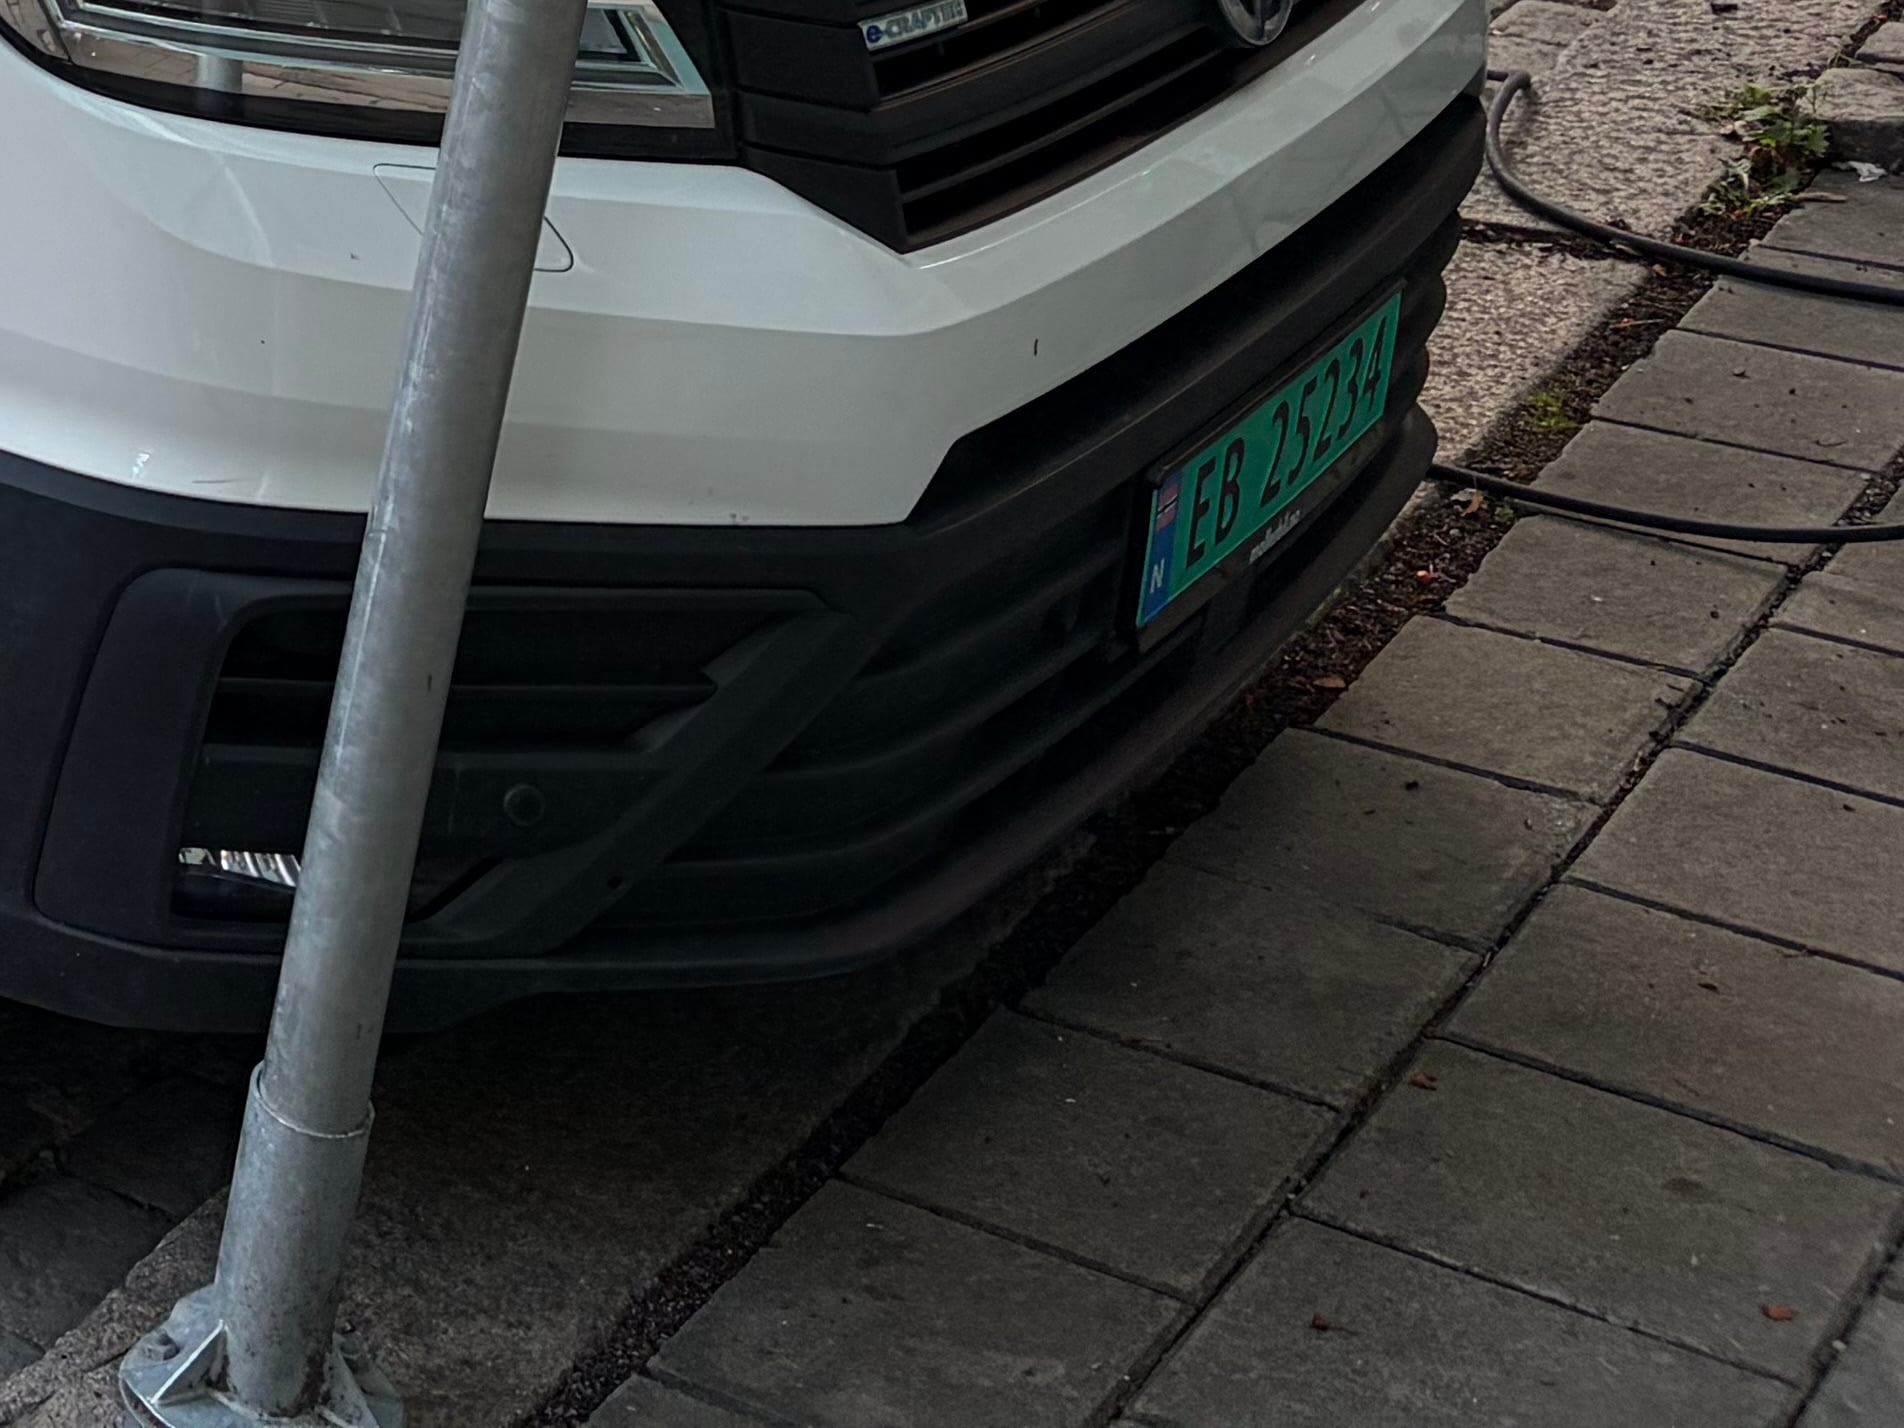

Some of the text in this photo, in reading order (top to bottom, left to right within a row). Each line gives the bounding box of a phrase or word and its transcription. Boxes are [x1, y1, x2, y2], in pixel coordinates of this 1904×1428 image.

[1186, 315, 1388, 569] EB 25234
[1150, 559, 1165, 593] N
